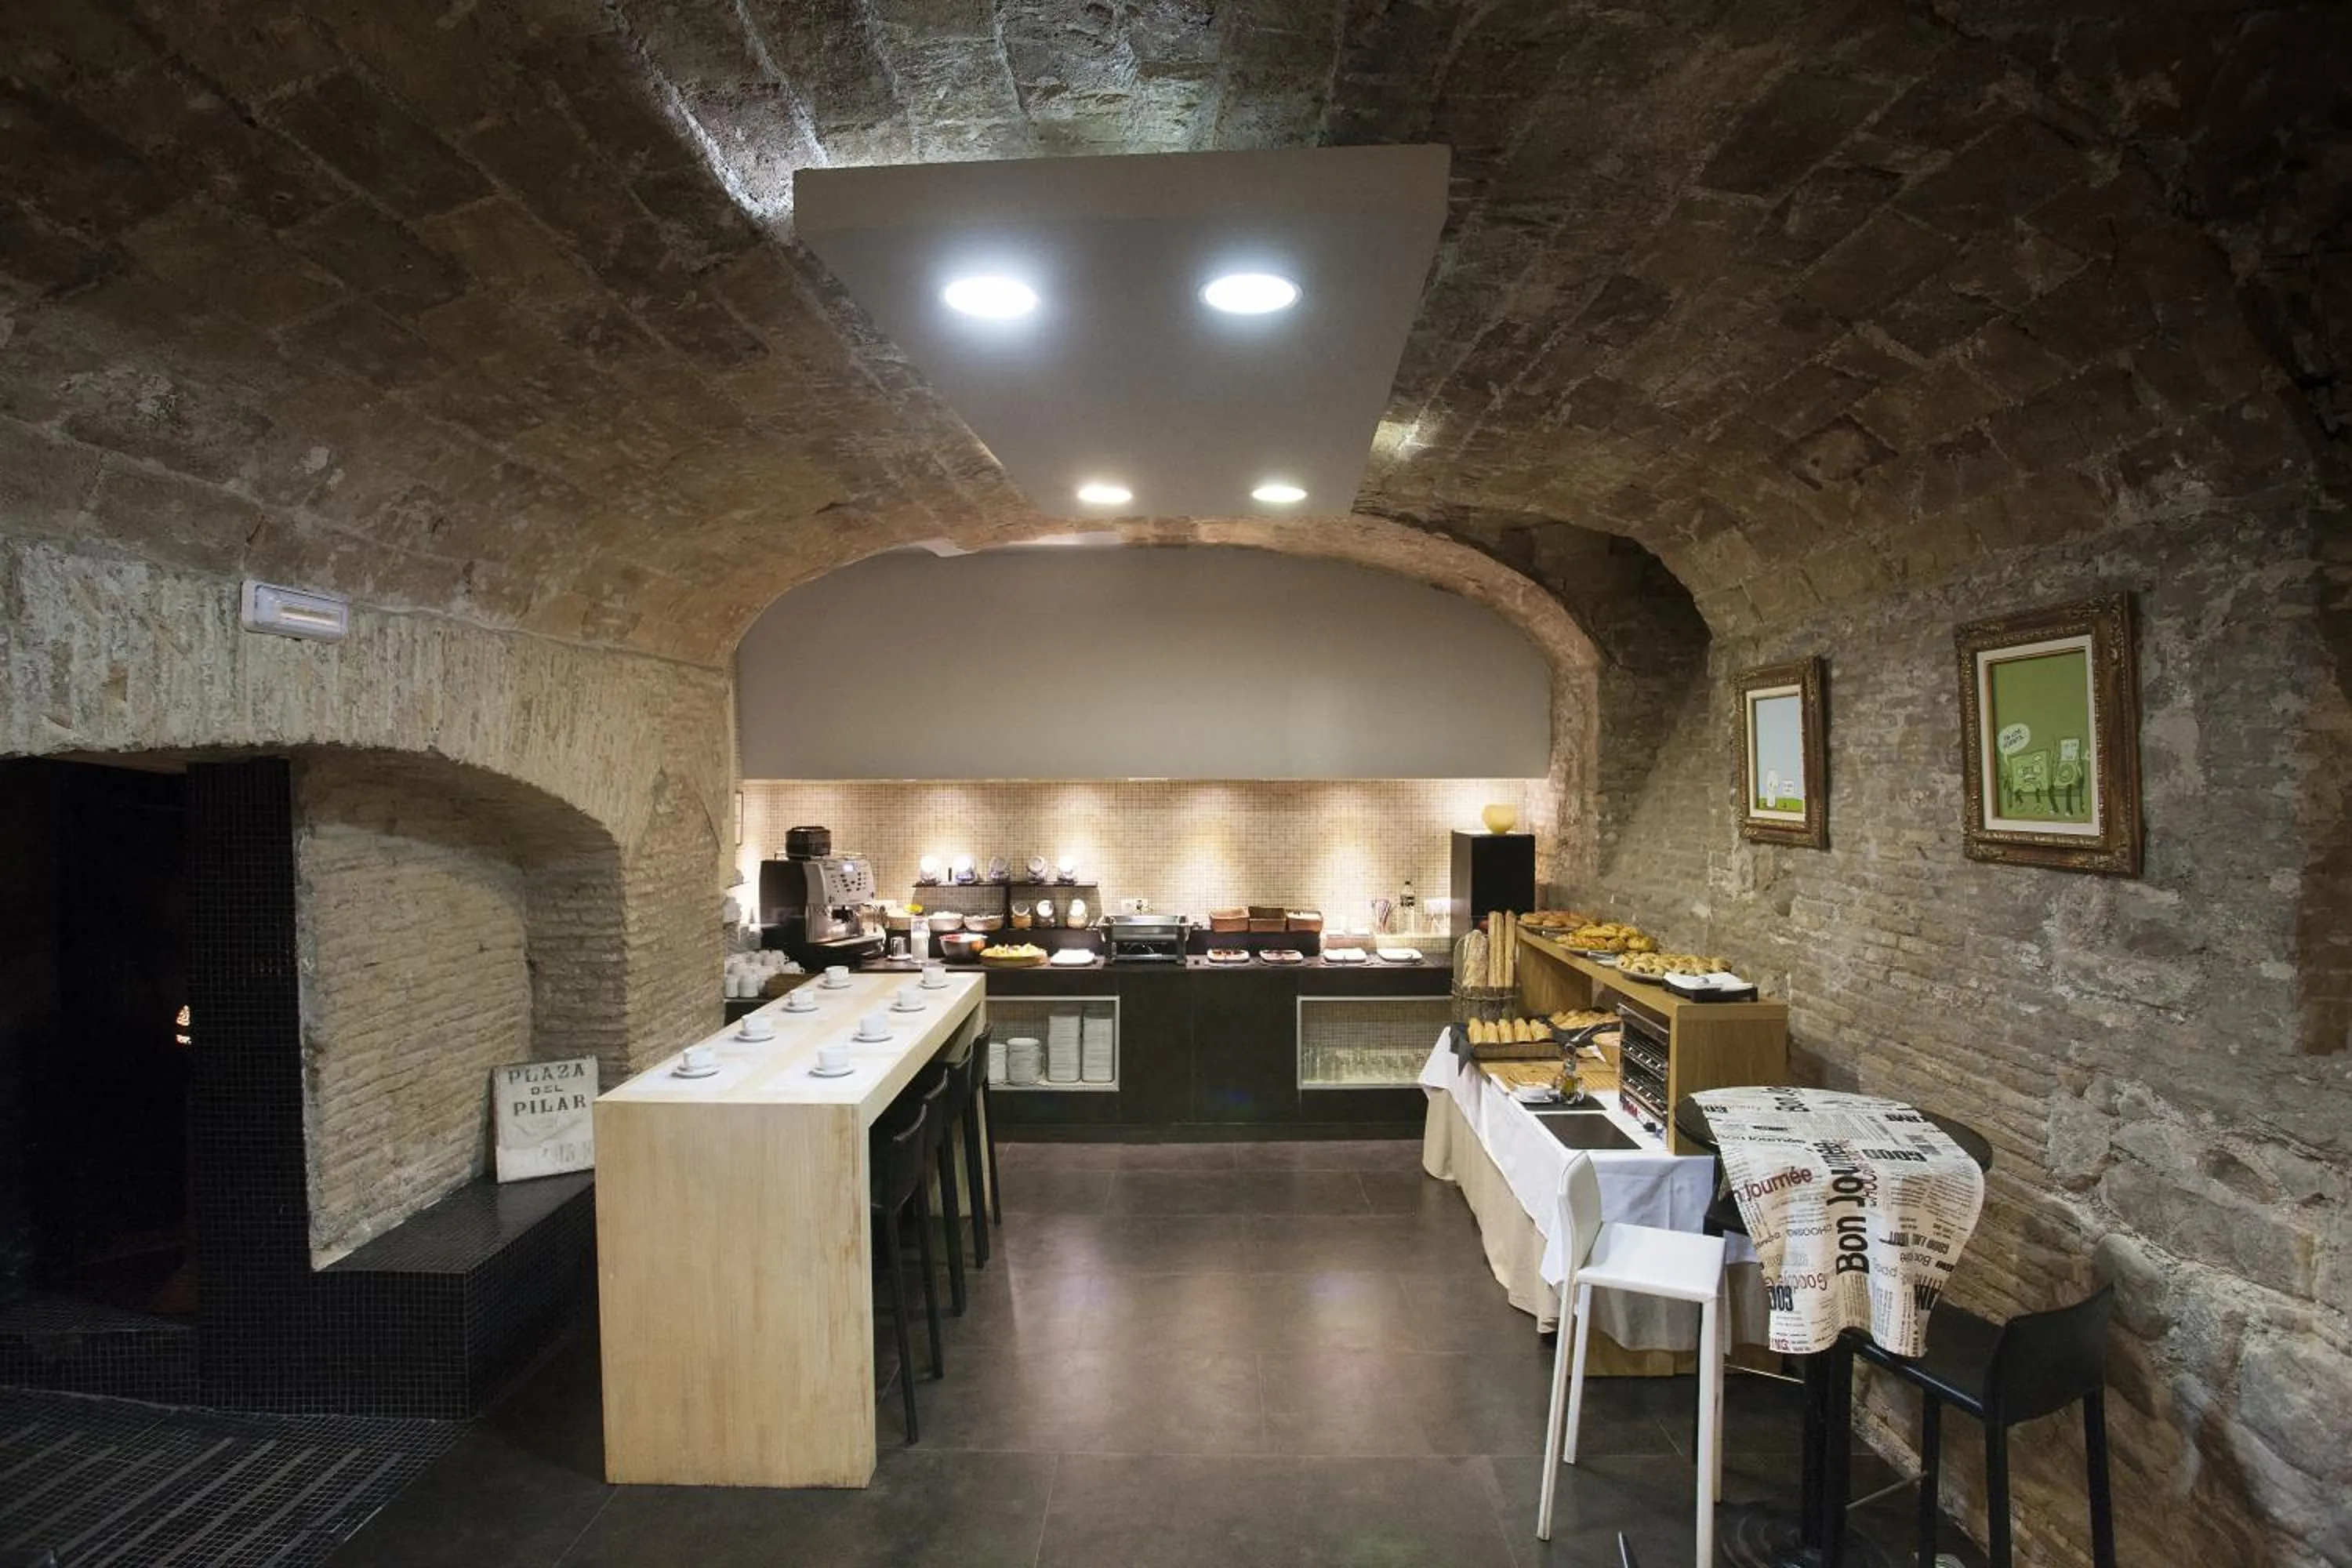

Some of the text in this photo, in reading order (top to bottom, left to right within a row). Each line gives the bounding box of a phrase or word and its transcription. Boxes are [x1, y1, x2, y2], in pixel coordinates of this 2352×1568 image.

[508, 1062, 585, 1085] PLAZA
[531, 1084, 564, 1095] DEL
[514, 1094, 587, 1116] PILAR
[1835, 1216, 1870, 1276] Bon
